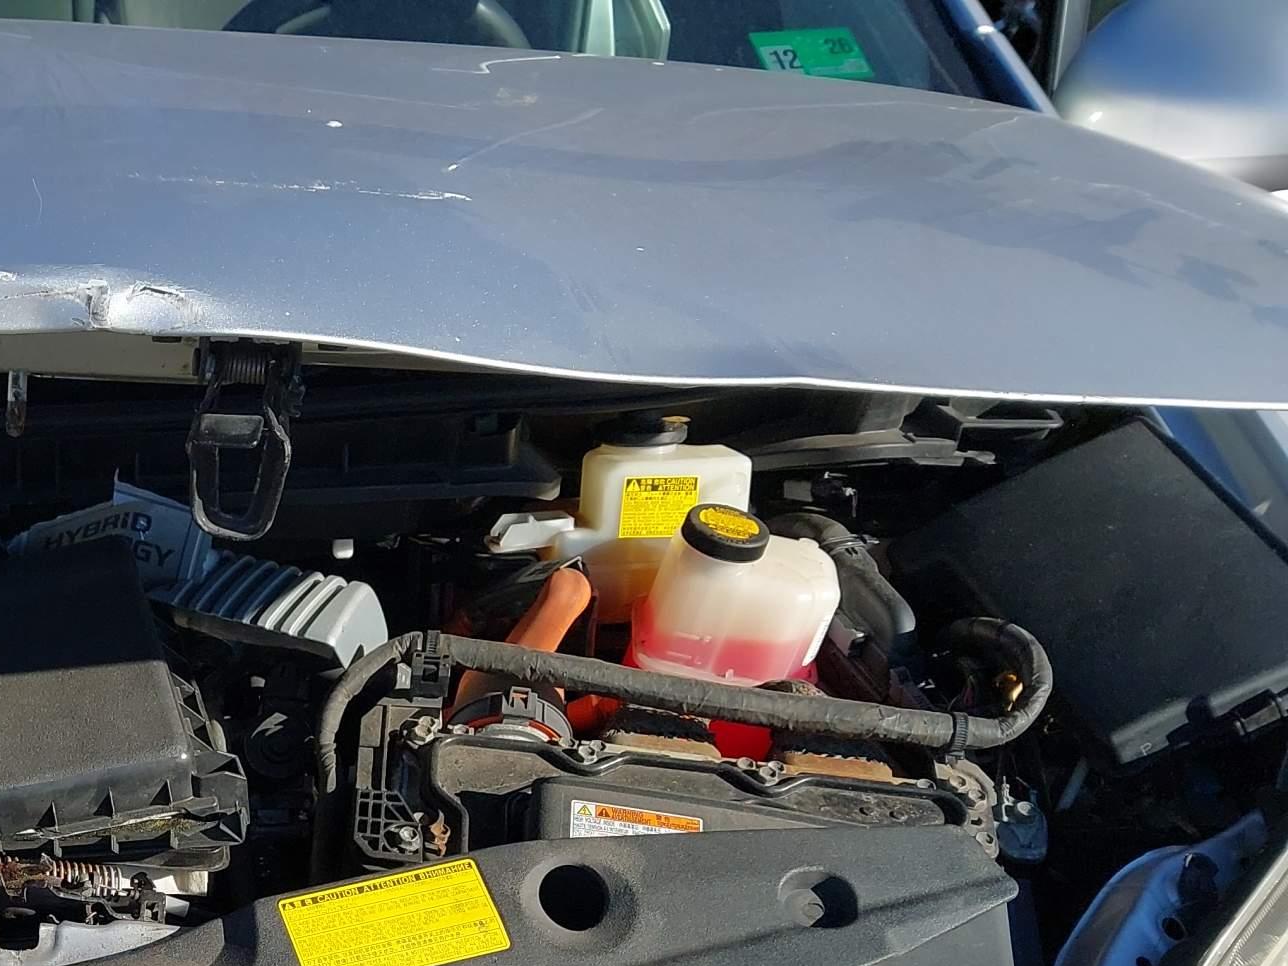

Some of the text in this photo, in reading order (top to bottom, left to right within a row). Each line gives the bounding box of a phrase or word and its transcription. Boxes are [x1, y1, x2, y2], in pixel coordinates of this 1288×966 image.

[769, 49, 802, 70] 12
[316, 887, 360, 903] CAUTION
[362, 874, 416, 893] ATTENTION
